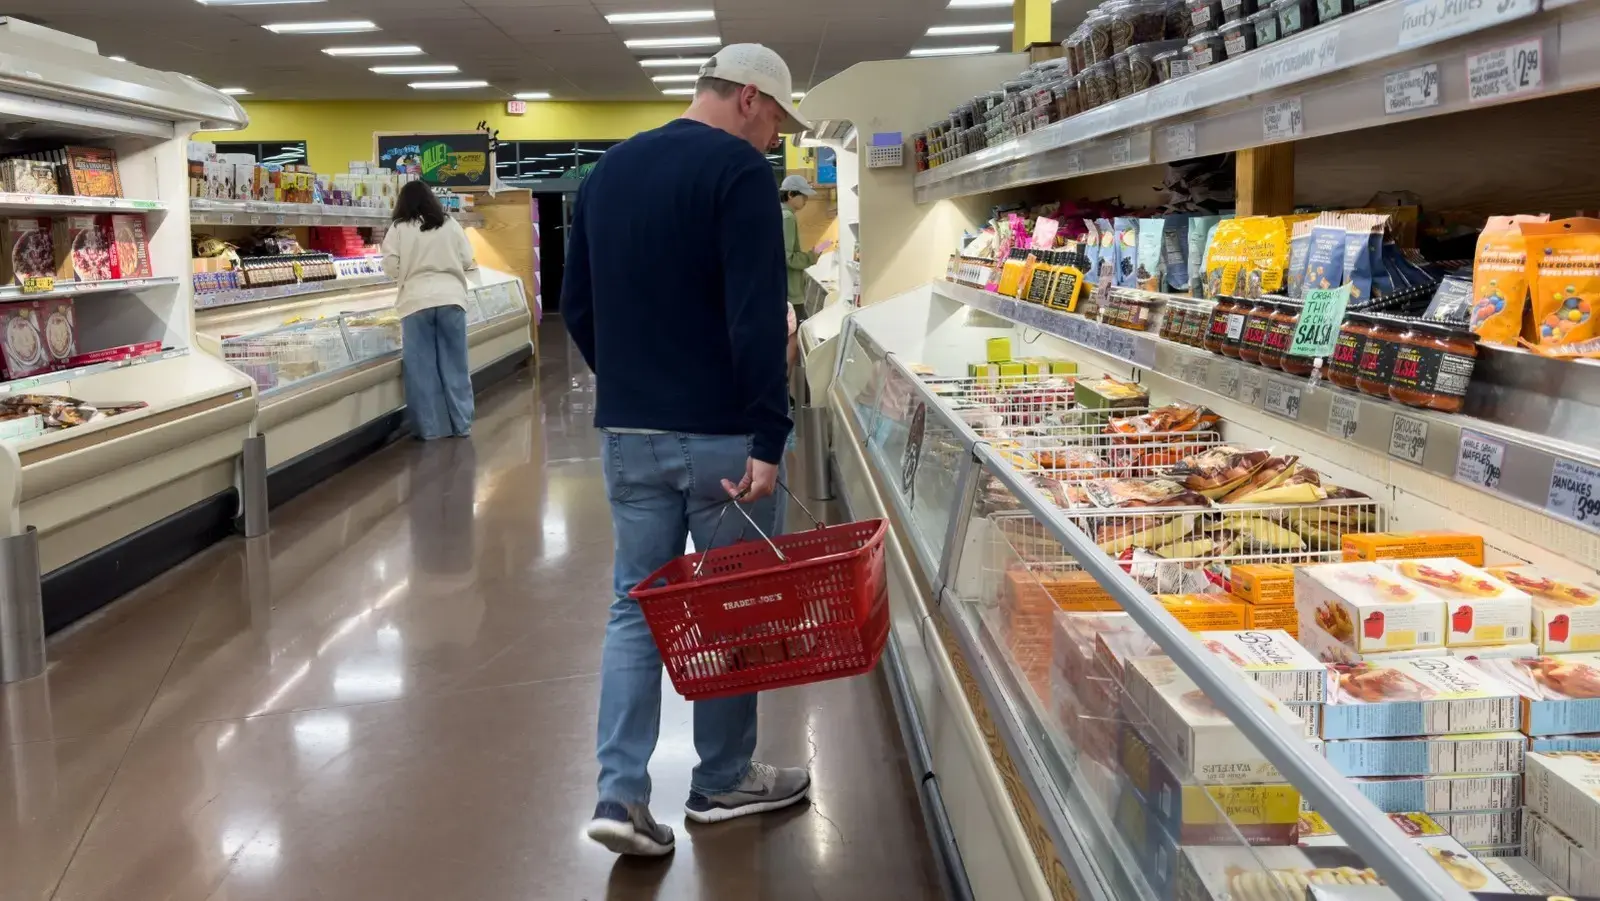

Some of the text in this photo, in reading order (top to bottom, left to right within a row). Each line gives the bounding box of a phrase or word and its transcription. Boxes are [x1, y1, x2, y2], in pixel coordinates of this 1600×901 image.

[1517, 49, 1538, 87] 2.99
[1423, 71, 1438, 98] 2.99
[1295, 324, 1333, 346] SALSA
[1395, 416, 1422, 436] BRIOCHE
[1410, 436, 1425, 458] 3.99
[1462, 448, 1491, 466] WAFFLES
[1552, 475, 1592, 498] PANCAKES
[1577, 496, 1600, 521] 3.99
[722, 593, 783, 611] TRADER JOE'S
[1202, 763, 1252, 774] WAFFLES
